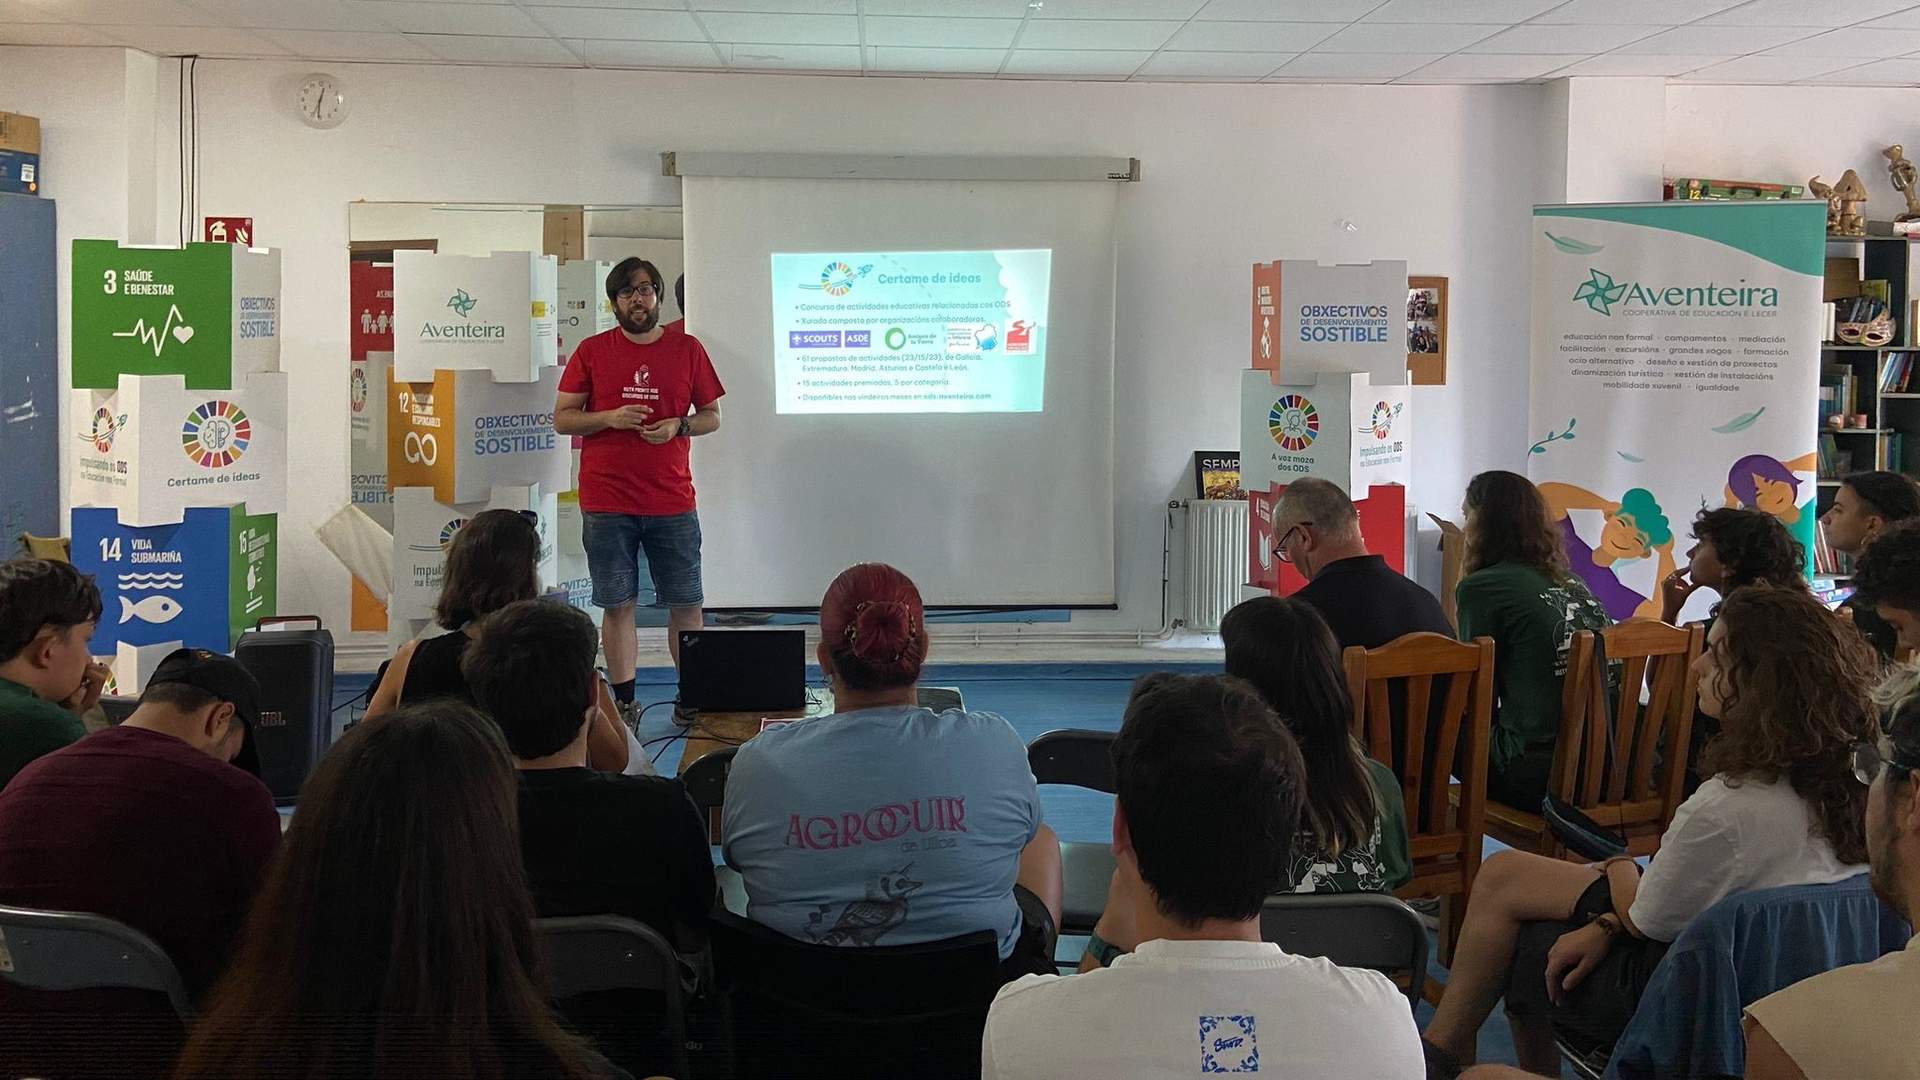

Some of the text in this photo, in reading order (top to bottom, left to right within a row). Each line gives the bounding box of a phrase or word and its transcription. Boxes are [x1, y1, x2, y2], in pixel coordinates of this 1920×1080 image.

[124, 269, 153, 282] SAÚDE
[878, 271, 982, 285] Certame de ideas
[103, 269, 117, 295] 3
[124, 284, 175, 296] E BENESTAR
[1623, 279, 1778, 307] Aventeira
[800, 303, 835, 311] Concurso
[836, 302, 846, 311] de
[847, 301, 889, 311] actividades
[890, 301, 930, 311] educativas
[932, 301, 979, 310] relacionadas
[994, 300, 1011, 309] ODS
[1300, 305, 1388, 318] OBXECTIVOS
[1622, 309, 1677, 317] COOPERATIVA
[1679, 309, 1691, 317] DE
[866, 318, 878, 327] por
[240, 320, 275, 339] SOSTIBLE
[420, 320, 505, 338] Aventeira
[1300, 326, 1388, 342] SOSTIBLE
[803, 334, 839, 344] SCOUTS
[847, 334, 869, 343] ASDE
[1563, 332, 1607, 341] educación
[1625, 333, 1653, 342] formal
[1664, 335, 1727, 343] campamentos
[1738, 334, 1786, 344] mediación
[1560, 344, 1606, 353] facilitación
[1615, 345, 1660, 353] excursións
[1668, 345, 1732, 356] grandes xogos
[1743, 346, 1789, 356] formación
[811, 355, 847, 363] propostas
[848, 354, 858, 362] de
[859, 353, 901, 362] actividades
[945, 353, 955, 361] de
[1568, 356, 1634, 366] ocio alternativo
[1646, 357, 1678, 367] deseño
[1686, 358, 1718, 368] xestión
[1720, 358, 1732, 368] de
[1733, 359, 1778, 369] proxectos
[879, 364, 908, 372] Asturias
[1571, 368, 1664, 378] dinamización turística
[1674, 370, 1773, 381] xestión de instalacións
[811, 379, 852, 387] actividades
[901, 379, 913, 388] por
[1603, 381, 1682, 391] mobilidade xuvenil
[1695, 383, 1740, 393] igualdade
[399, 391, 409, 413] 12
[474, 412, 555, 430] OBXECTIVOS
[474, 427, 555, 439] DE DESENVOLVEMENTO
[474, 434, 555, 455] SOSTIBLE
[1271, 453, 1315, 464] A voz moza
[1277, 463, 1310, 473] dos ODS
[167, 472, 260, 488] Certame de ideas
[131, 538, 152, 550] VIDA
[239, 530, 247, 555] 15
[99, 537, 122, 562] 14
[131, 551, 182, 564] SUBMARIÑA
[413, 563, 442, 578] Impul
[260, 711, 286, 727] JBL
[785, 795, 968, 851] AGROCUIR
